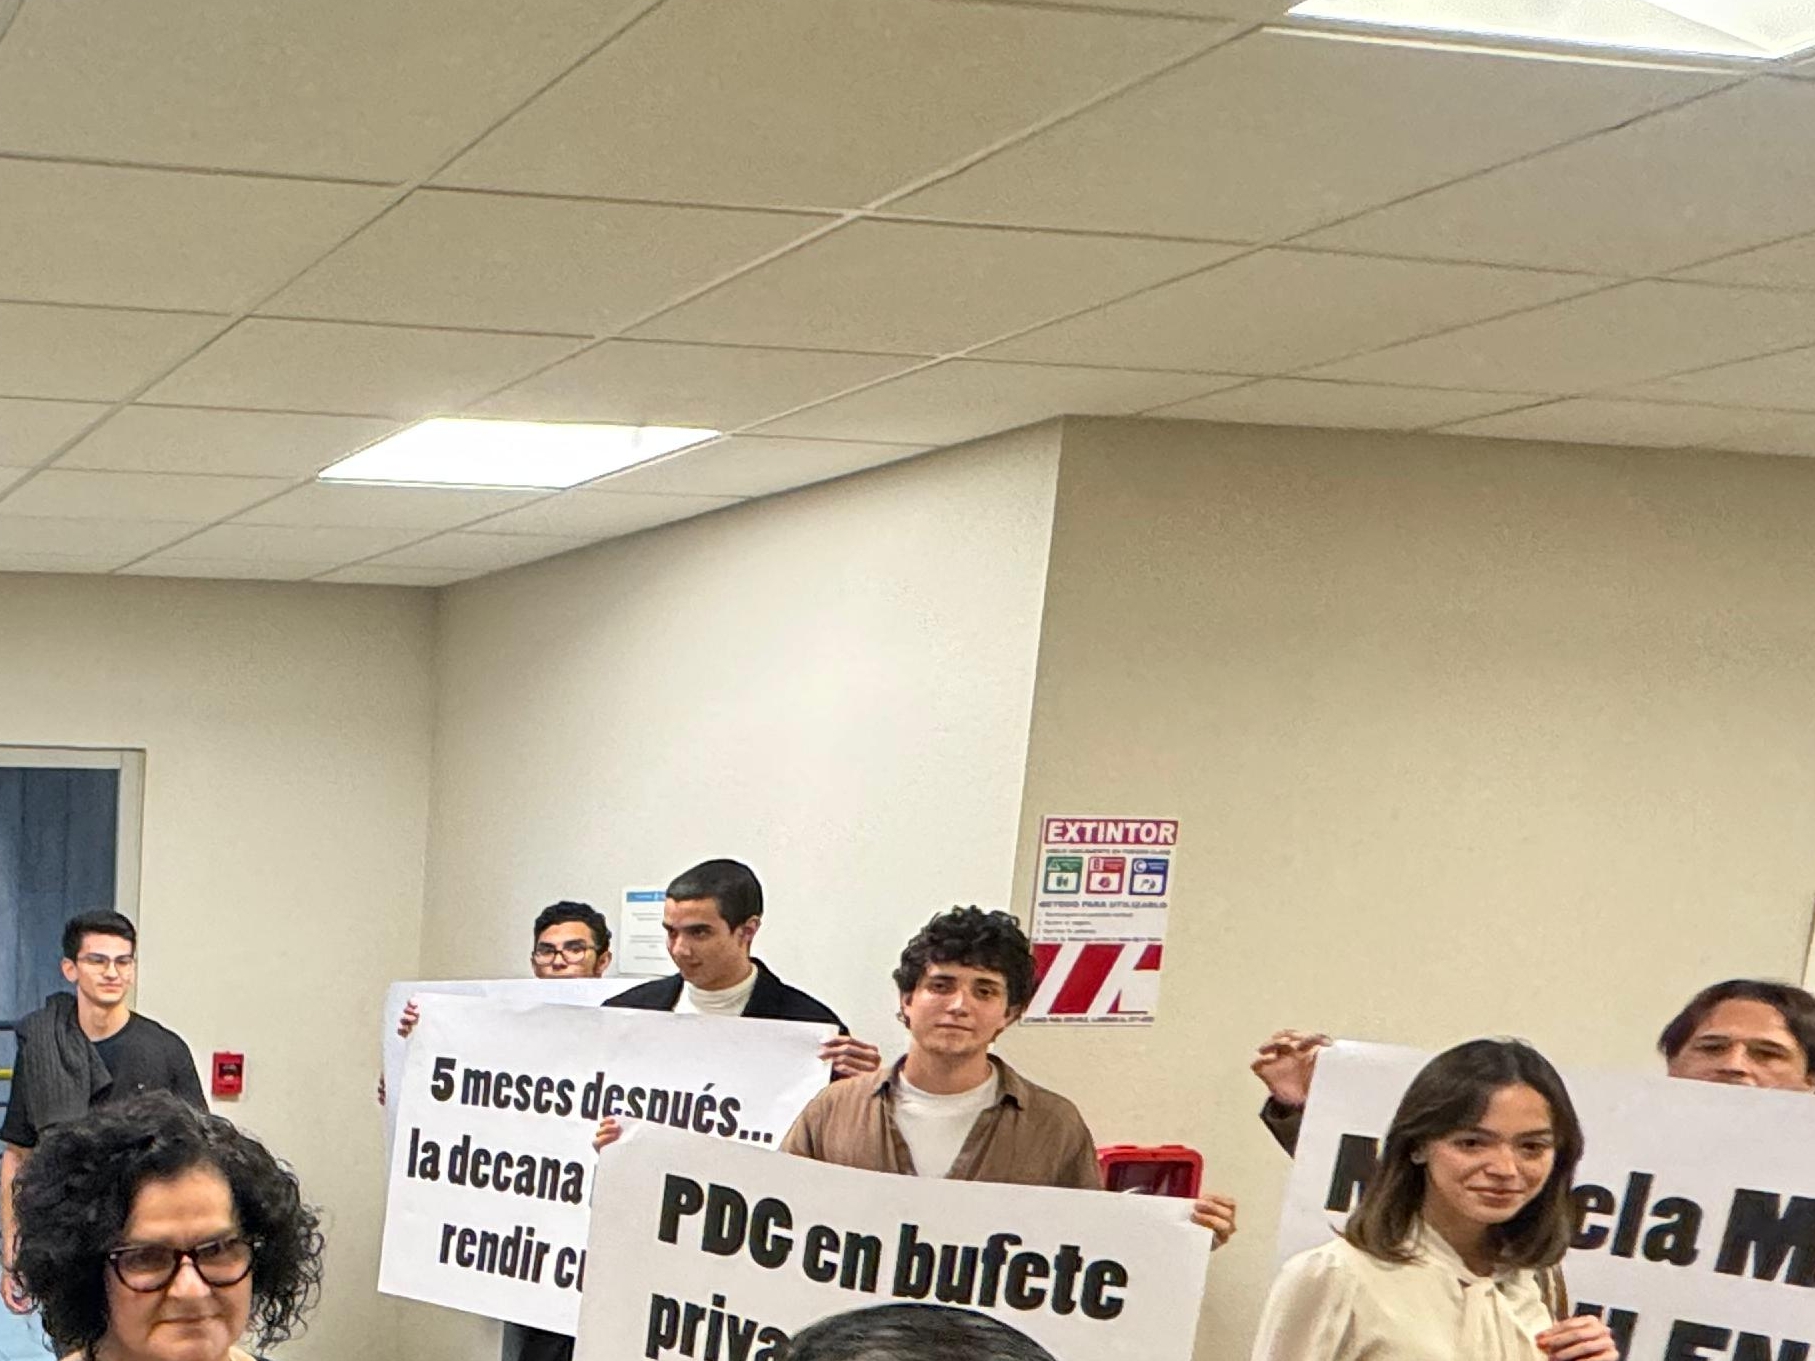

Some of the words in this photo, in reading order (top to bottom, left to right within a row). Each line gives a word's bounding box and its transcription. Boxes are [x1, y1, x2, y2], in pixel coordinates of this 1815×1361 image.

[1047, 821, 1176, 844] EXTINTOR
[431, 1057, 457, 1101] 5
[461, 1066, 575, 1116] meses
[581, 1071, 773, 1144] después...
[407, 1128, 440, 1182] la
[448, 1135, 584, 1206] decana
[439, 1223, 550, 1284] rendir
[802, 1224, 883, 1293] en
[892, 1223, 1128, 1320] bufete
